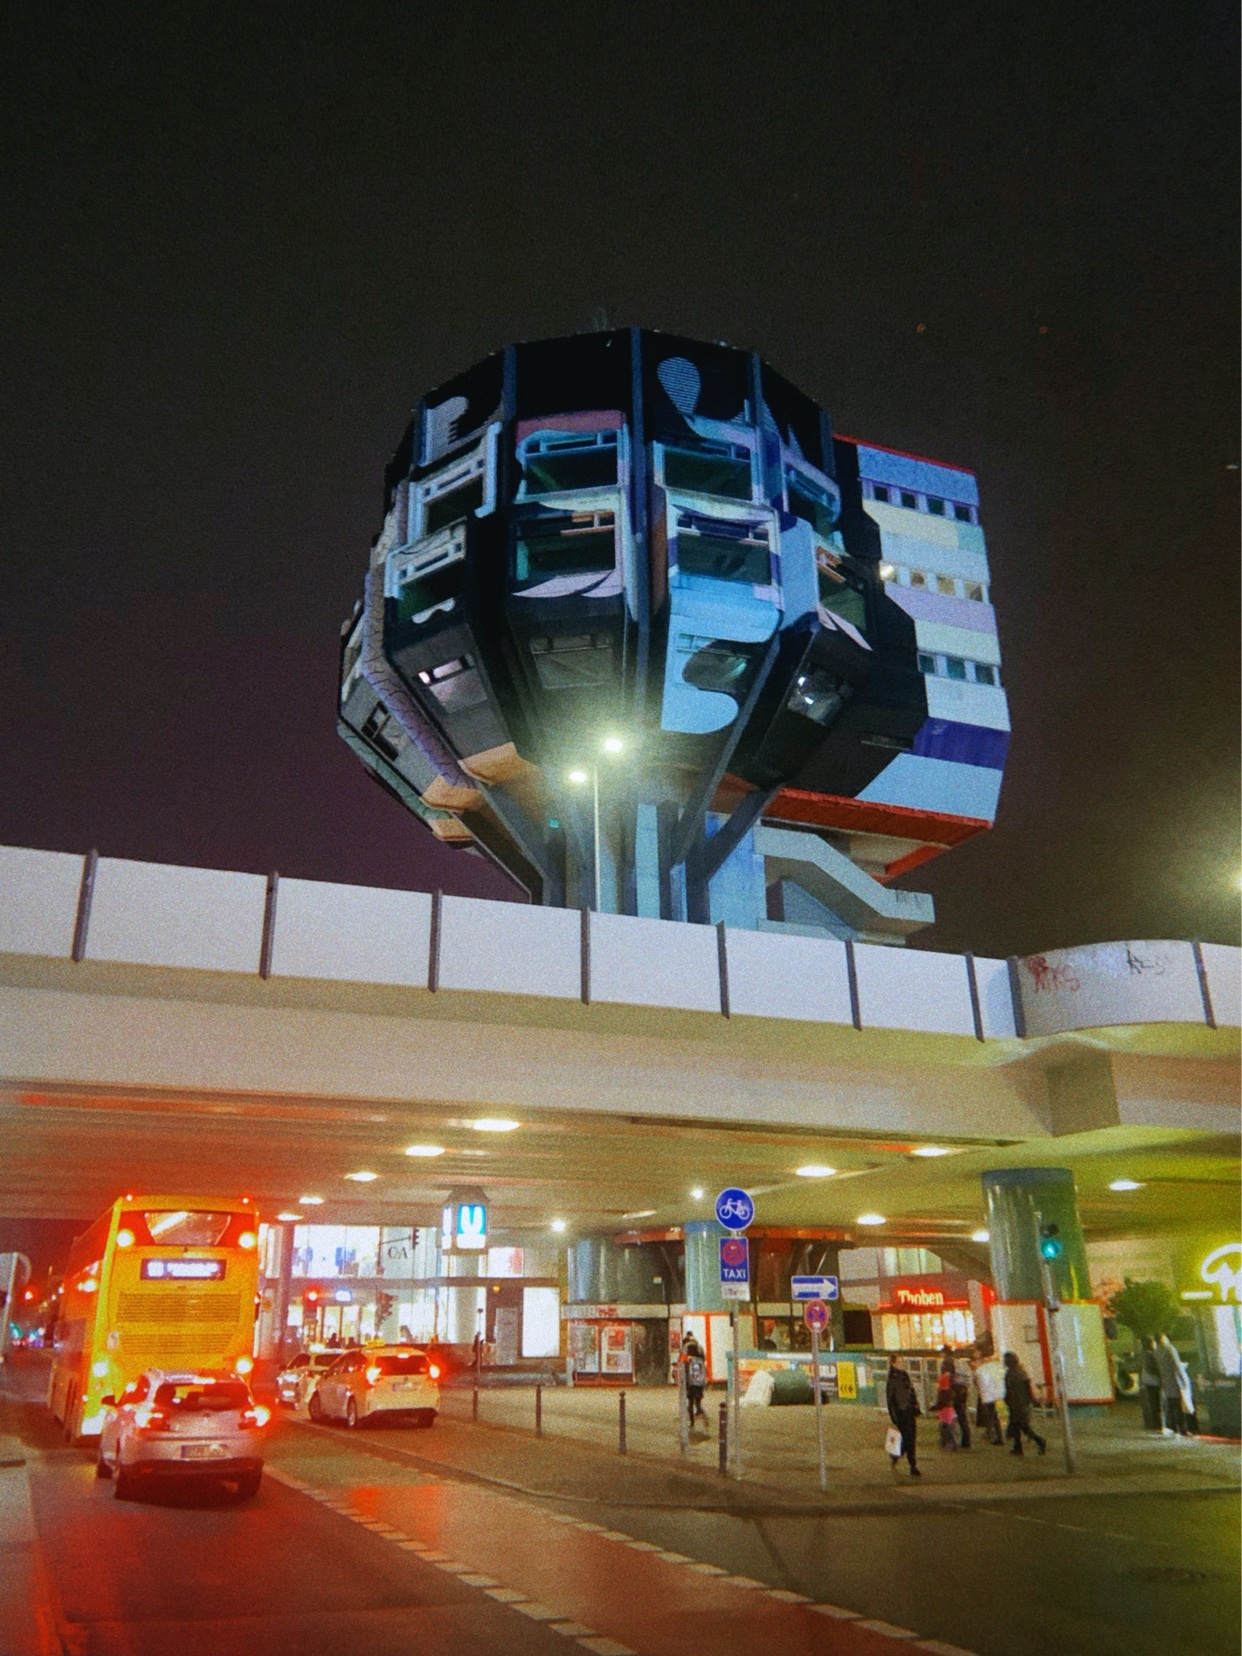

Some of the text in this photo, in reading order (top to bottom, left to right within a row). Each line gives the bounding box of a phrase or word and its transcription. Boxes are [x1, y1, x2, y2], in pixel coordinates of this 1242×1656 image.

[461, 1206, 483, 1236] U
[722, 1268, 747, 1279] TAXI
[897, 1288, 945, 1306] Thoben
